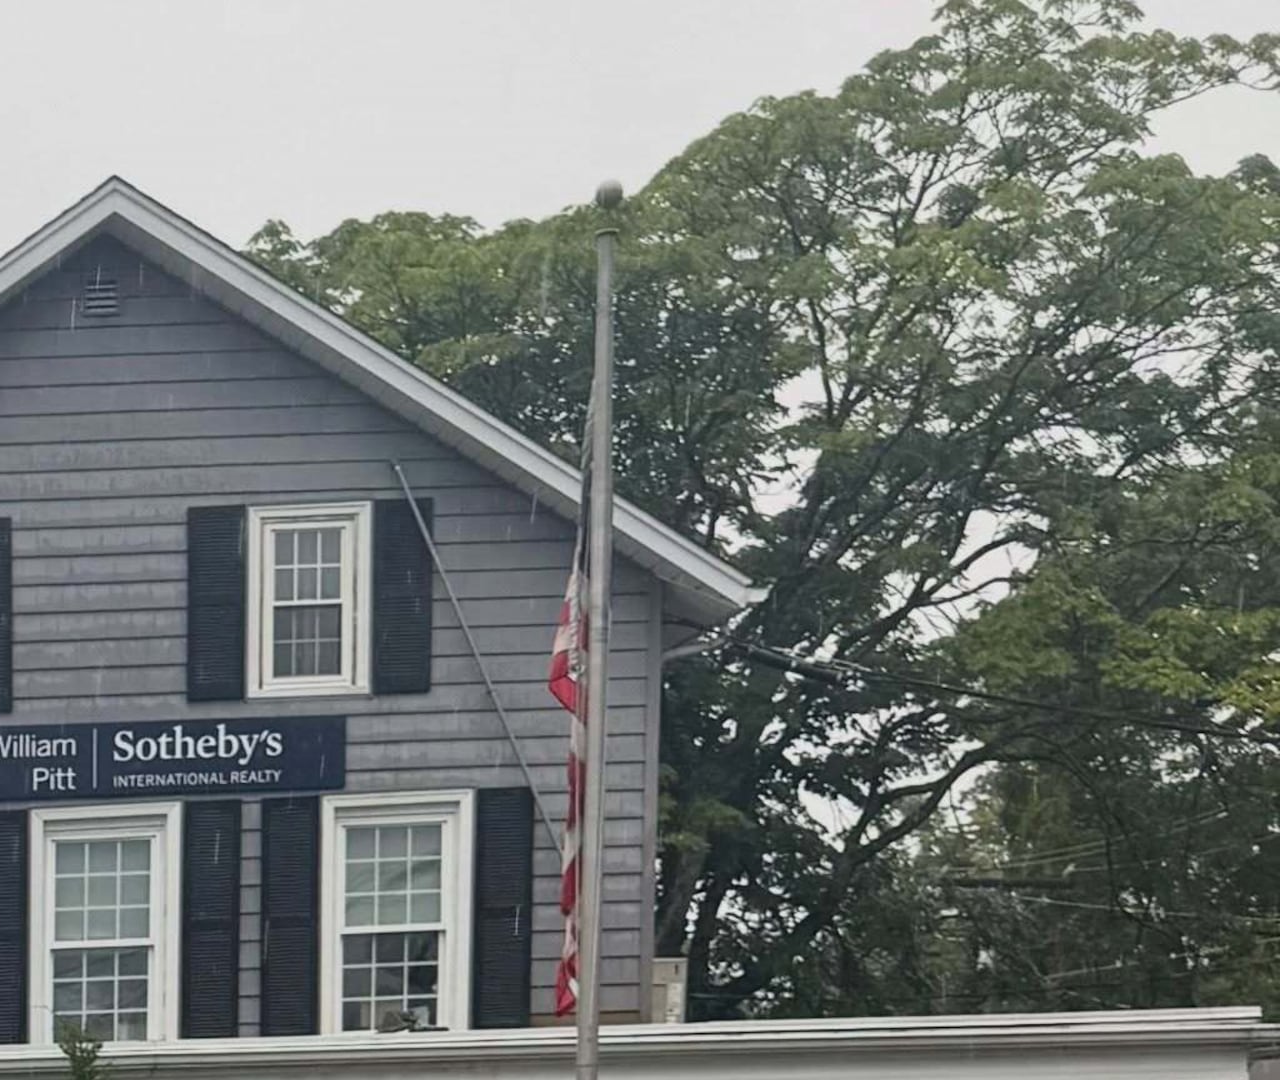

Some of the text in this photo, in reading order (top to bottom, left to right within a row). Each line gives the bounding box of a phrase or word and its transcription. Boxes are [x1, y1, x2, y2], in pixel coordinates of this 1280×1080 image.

[113, 724, 283, 765] Sotheby's
[32, 767, 77, 791] Pitt
[113, 768, 282, 788] INTERNATIONAL REALTY
